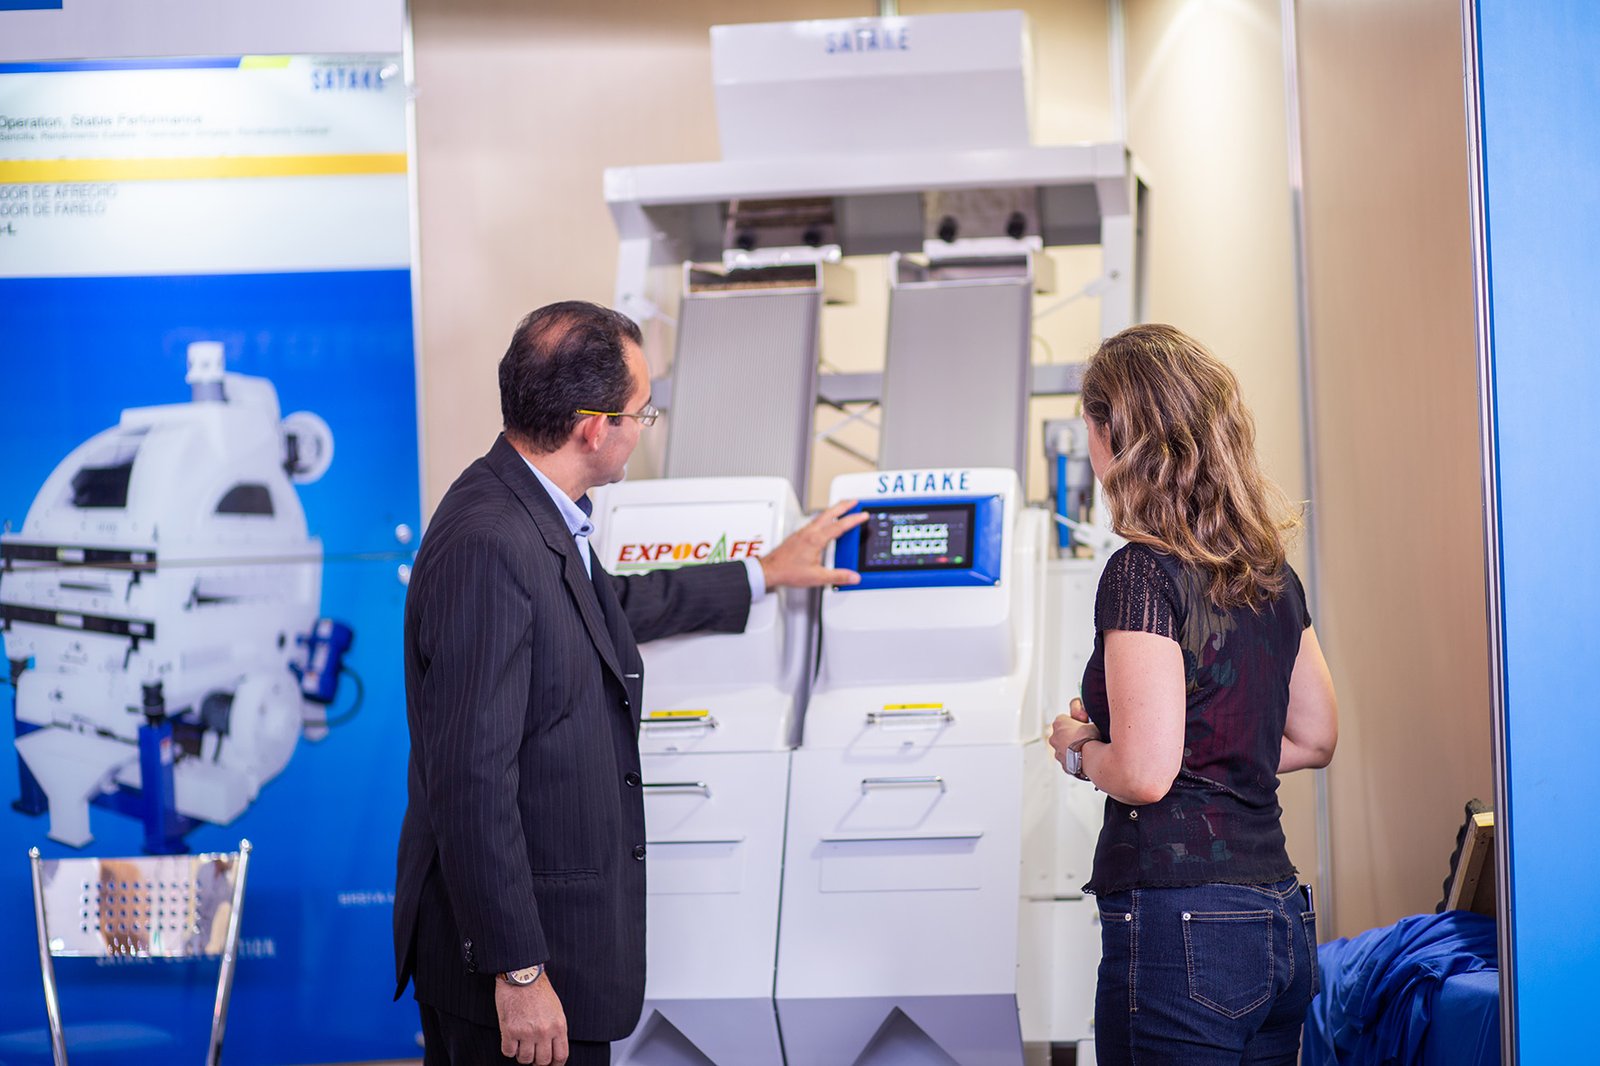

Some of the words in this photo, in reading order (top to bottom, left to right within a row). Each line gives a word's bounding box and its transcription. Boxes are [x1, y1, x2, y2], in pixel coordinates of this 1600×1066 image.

[825, 27, 911, 54] SATAKE
[312, 66, 384, 91] SATAKE
[33, 185, 50, 200] DE
[33, 203, 50, 217] DE
[877, 471, 970, 494] SATAKE
